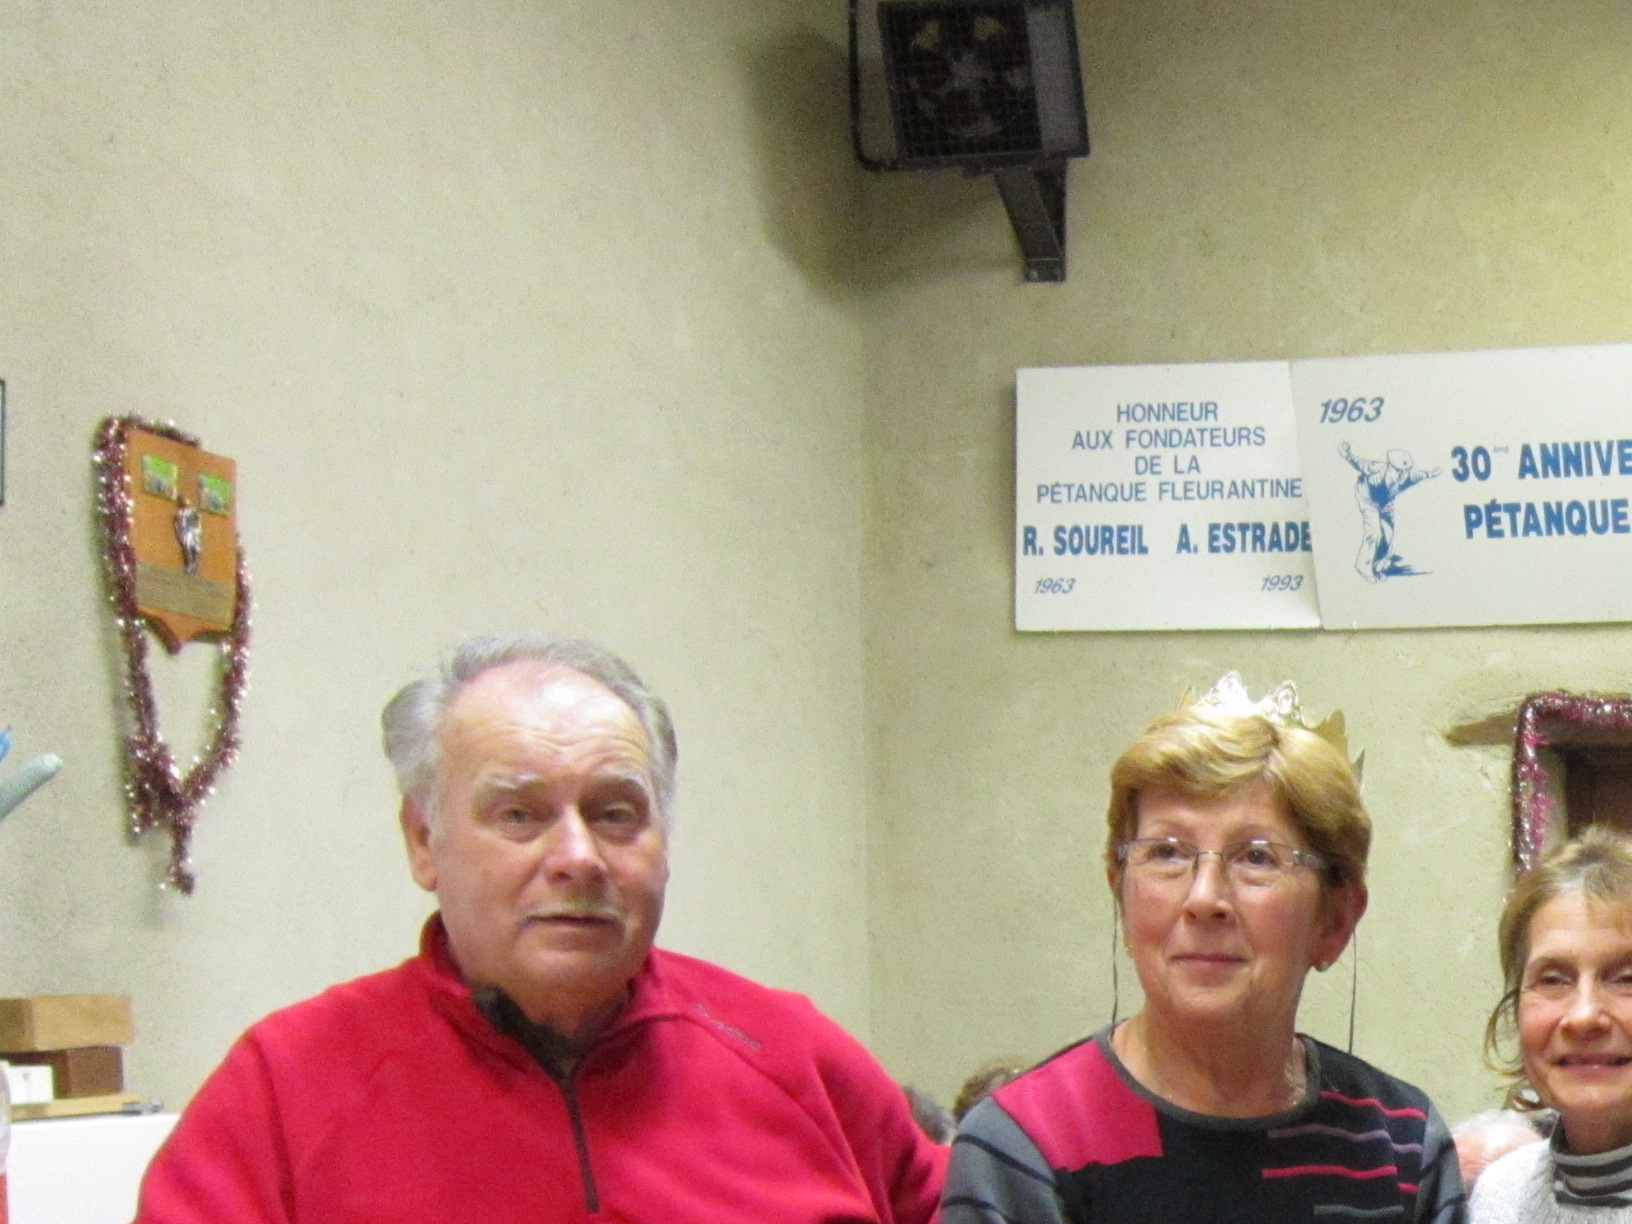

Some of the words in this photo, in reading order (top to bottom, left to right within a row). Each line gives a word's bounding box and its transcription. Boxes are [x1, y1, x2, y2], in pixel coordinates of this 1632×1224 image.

[1117, 402, 1218, 423] HONNEUR
[1320, 396, 1384, 424] 1963
[1072, 430, 1113, 450] AUX
[1125, 426, 1266, 449] FONDATEURS
[1135, 455, 1162, 475] DE
[1174, 455, 1201, 474] LA
[1037, 481, 1146, 504] PÉTANQUE
[1158, 478, 1303, 501] FLEURANTINE
[1464, 499, 1631, 540] PÉTANQUE
[1023, 525, 1044, 556] R.
[1054, 524, 1149, 556] SOUREIL
[1177, 523, 1198, 554] A.
[1208, 520, 1312, 553] ESTRADE
[1034, 577, 1076, 594] 1963
[1261, 574, 1304, 592] 1993
